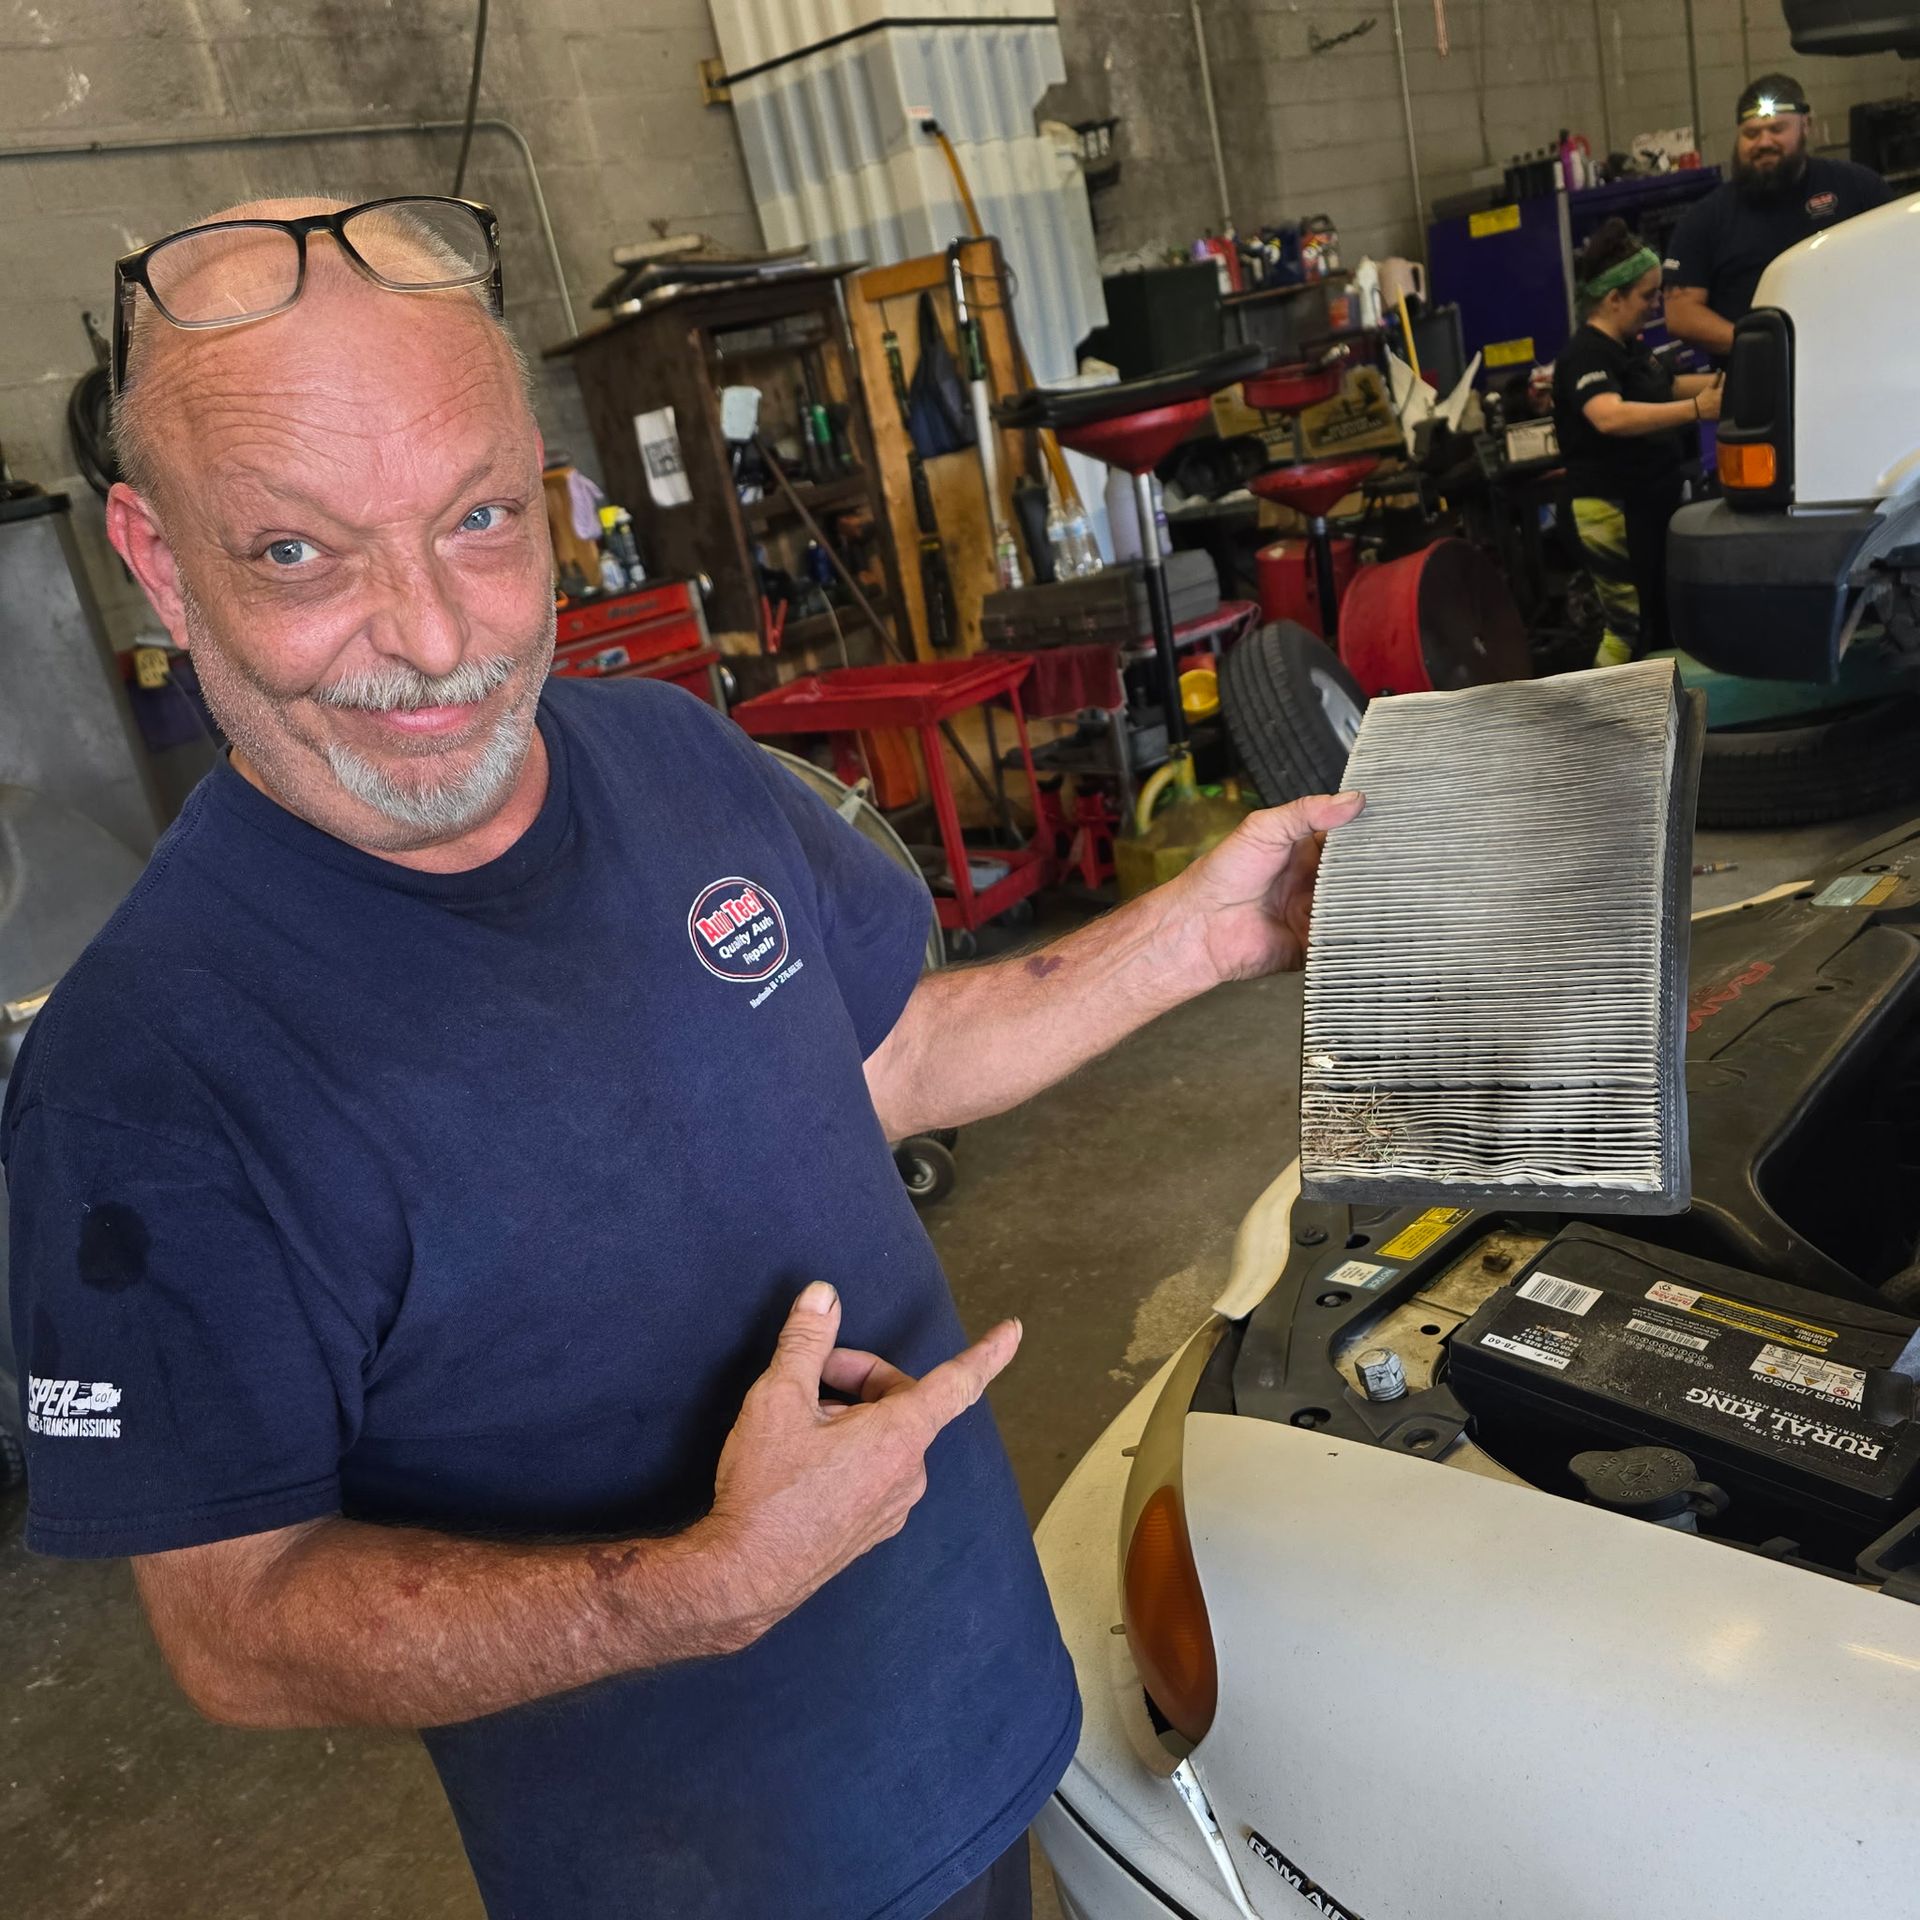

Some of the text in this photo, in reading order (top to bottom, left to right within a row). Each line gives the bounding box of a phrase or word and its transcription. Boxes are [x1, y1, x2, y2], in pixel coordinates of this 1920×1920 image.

[695, 910, 734, 947] Auto
[718, 915, 775, 960] Quality Auto
[742, 935, 776, 965] Repair
[1487, 1336, 1517, 1351] 78-60
[1542, 1345, 1571, 1357] GROUP
[1543, 1355, 1564, 1365] PART
[28, 1375, 112, 1417] SPER GO!
[1704, 1385, 1738, 1399] STORE
[1739, 1396, 1770, 1410] HOME
[1683, 1385, 1884, 1461] RURAL KING
[1782, 1409, 1812, 1422] FARM
[42, 1417, 121, 1439] TRANSMISSIONS
[1741, 1420, 1767, 1437] 1960
[1814, 1420, 1872, 1442] AMERICA'S
[1248, 1836, 1303, 1890] RAM
